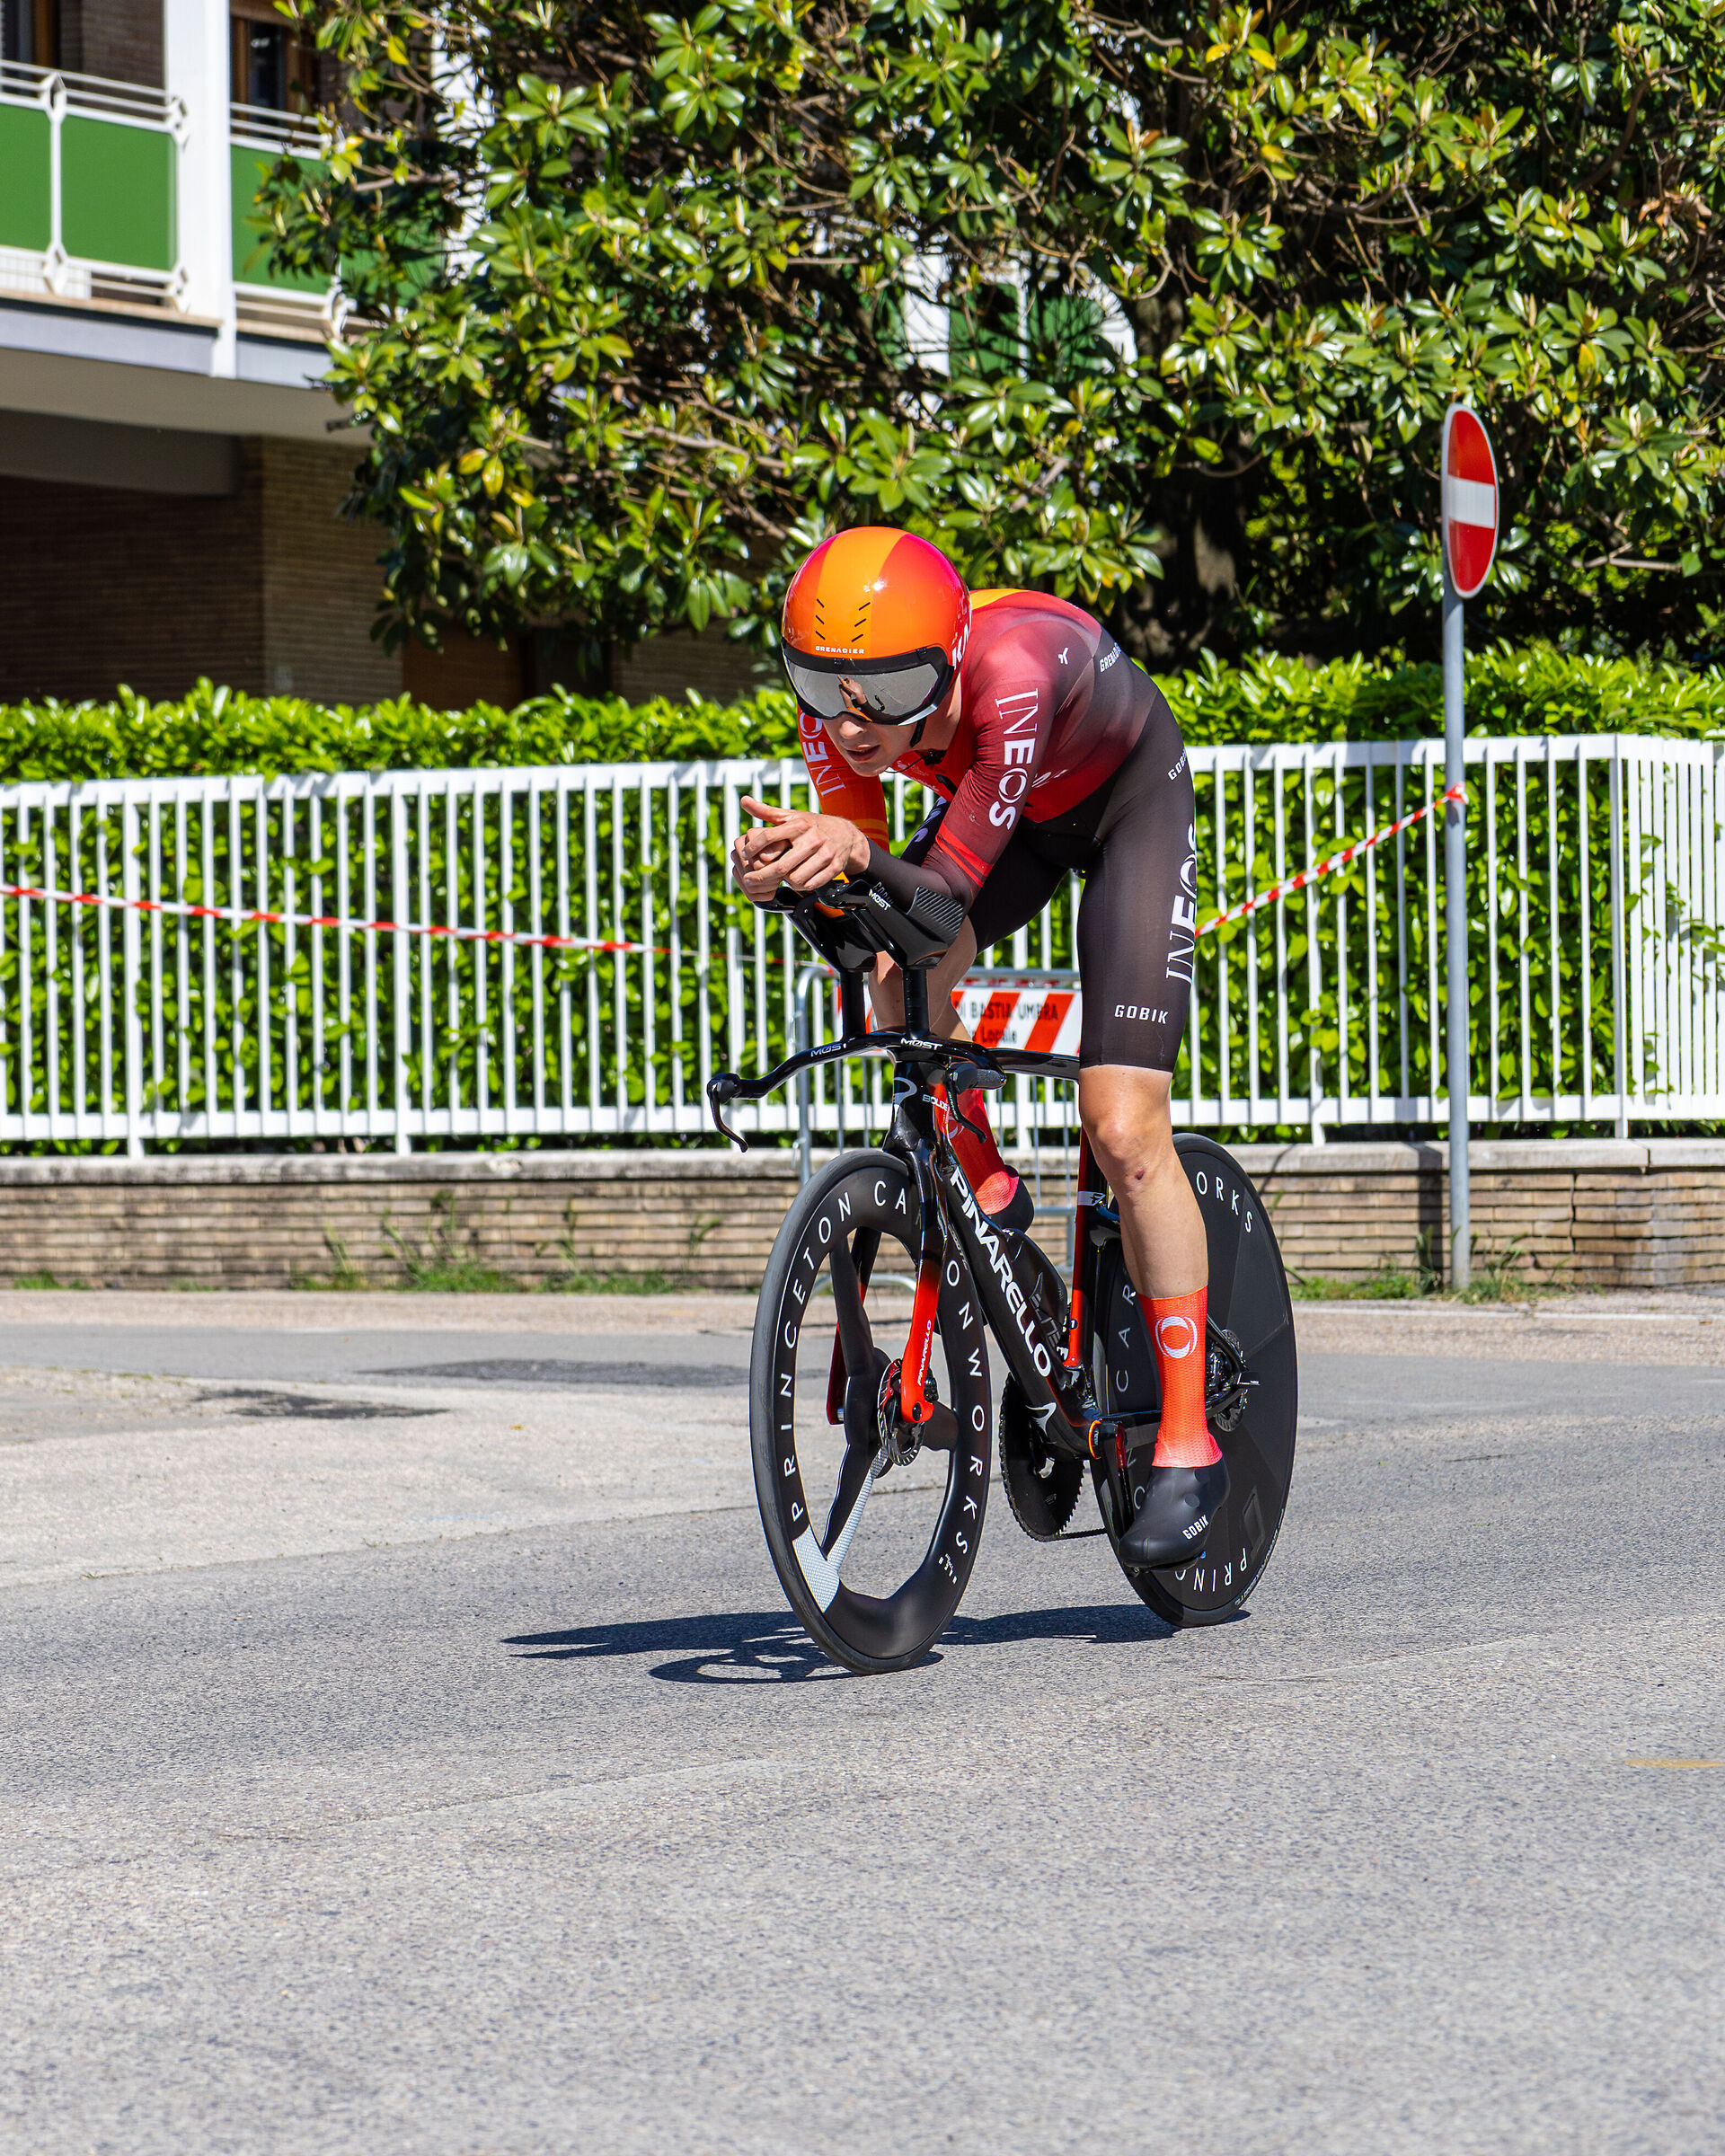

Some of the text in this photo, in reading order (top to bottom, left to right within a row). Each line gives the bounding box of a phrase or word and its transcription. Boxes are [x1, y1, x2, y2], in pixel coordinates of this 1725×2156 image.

[815, 645, 865, 655] GRENADIER
[800, 711, 846, 797] INEO
[989, 687, 1039, 830] INEOS
[970, 1002, 1012, 1019] BASTIA
[1017, 1003, 1058, 1021] UMBRA
[1114, 1003, 1169, 1025] GOBIK
[950, 1165, 1051, 1377] PINARELLO
[779, 1191, 852, 1524] PRINCETON
[917, 1319, 932, 1386] PINARELLO
[1182, 1515, 1208, 1539] GOBIK
